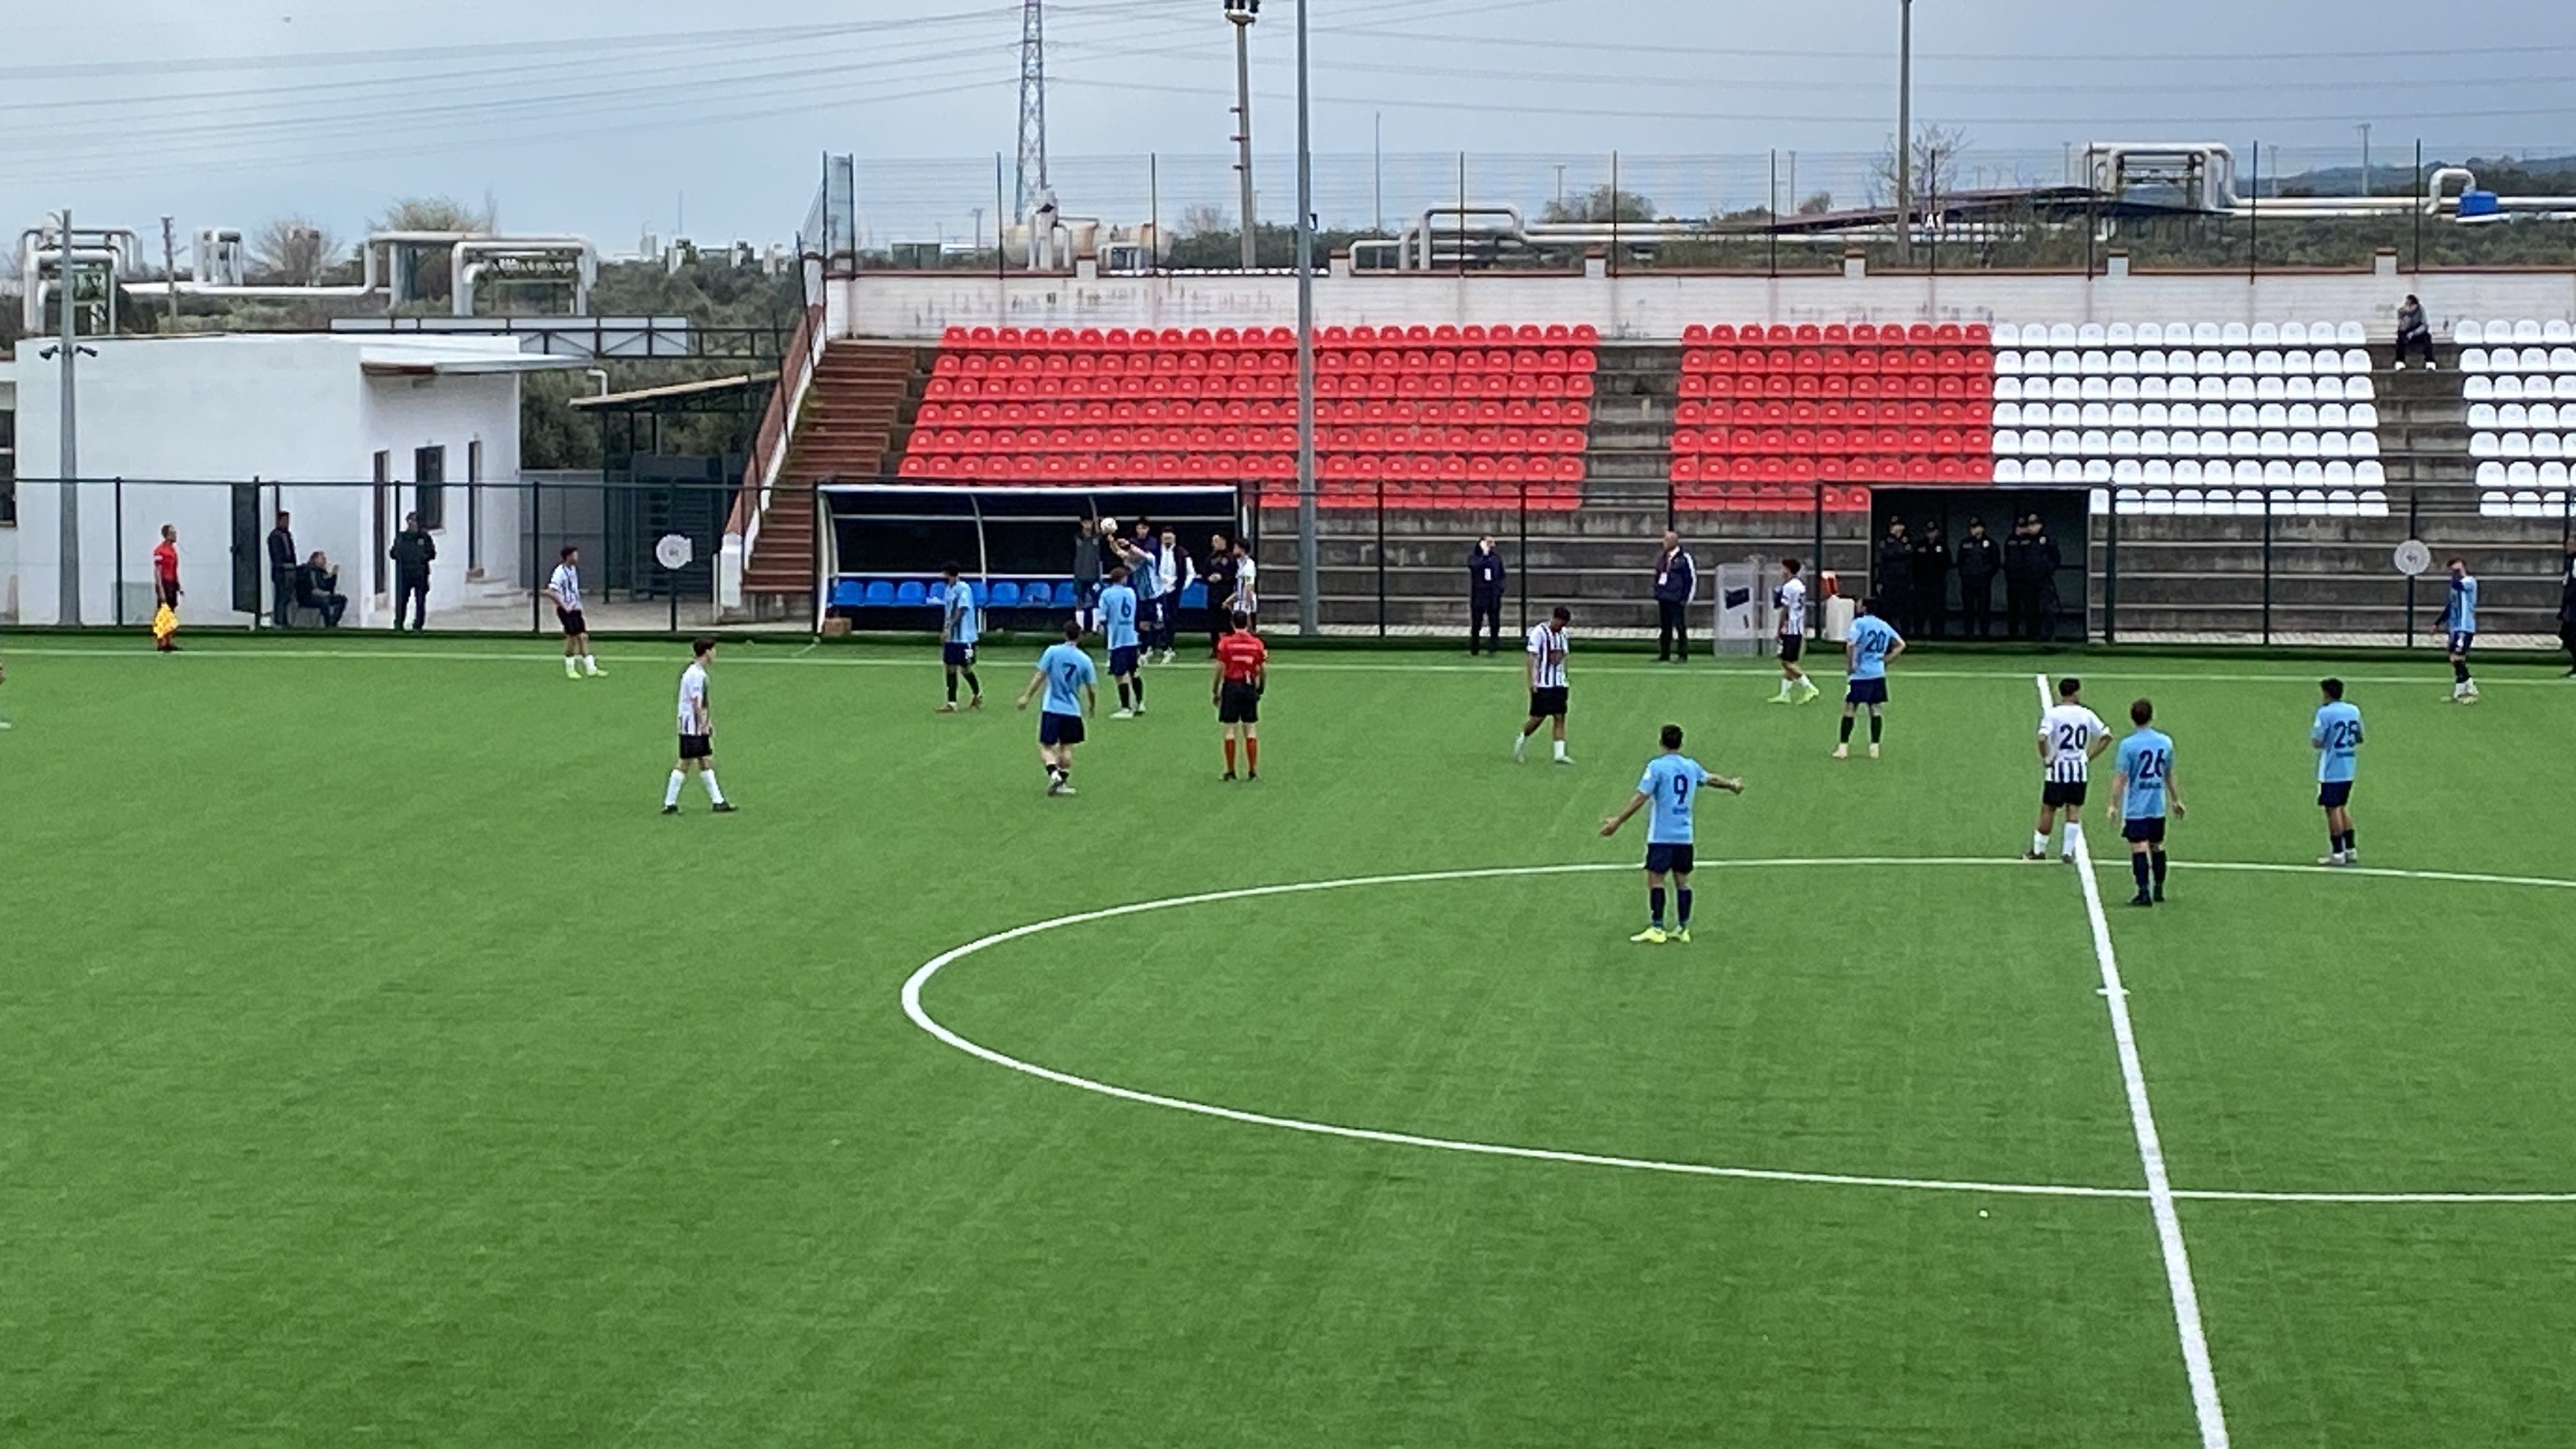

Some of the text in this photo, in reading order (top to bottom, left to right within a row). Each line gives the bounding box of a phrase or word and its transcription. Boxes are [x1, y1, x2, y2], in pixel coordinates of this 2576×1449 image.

[1120, 596, 1131, 618] 6
[1865, 629, 1887, 653] 20
[1062, 662, 1077, 682] 7
[2059, 724, 2087, 750] 20
[2334, 720, 2359, 748] 25
[2139, 749, 2166, 778] 26
[1674, 774, 1688, 805] 9
